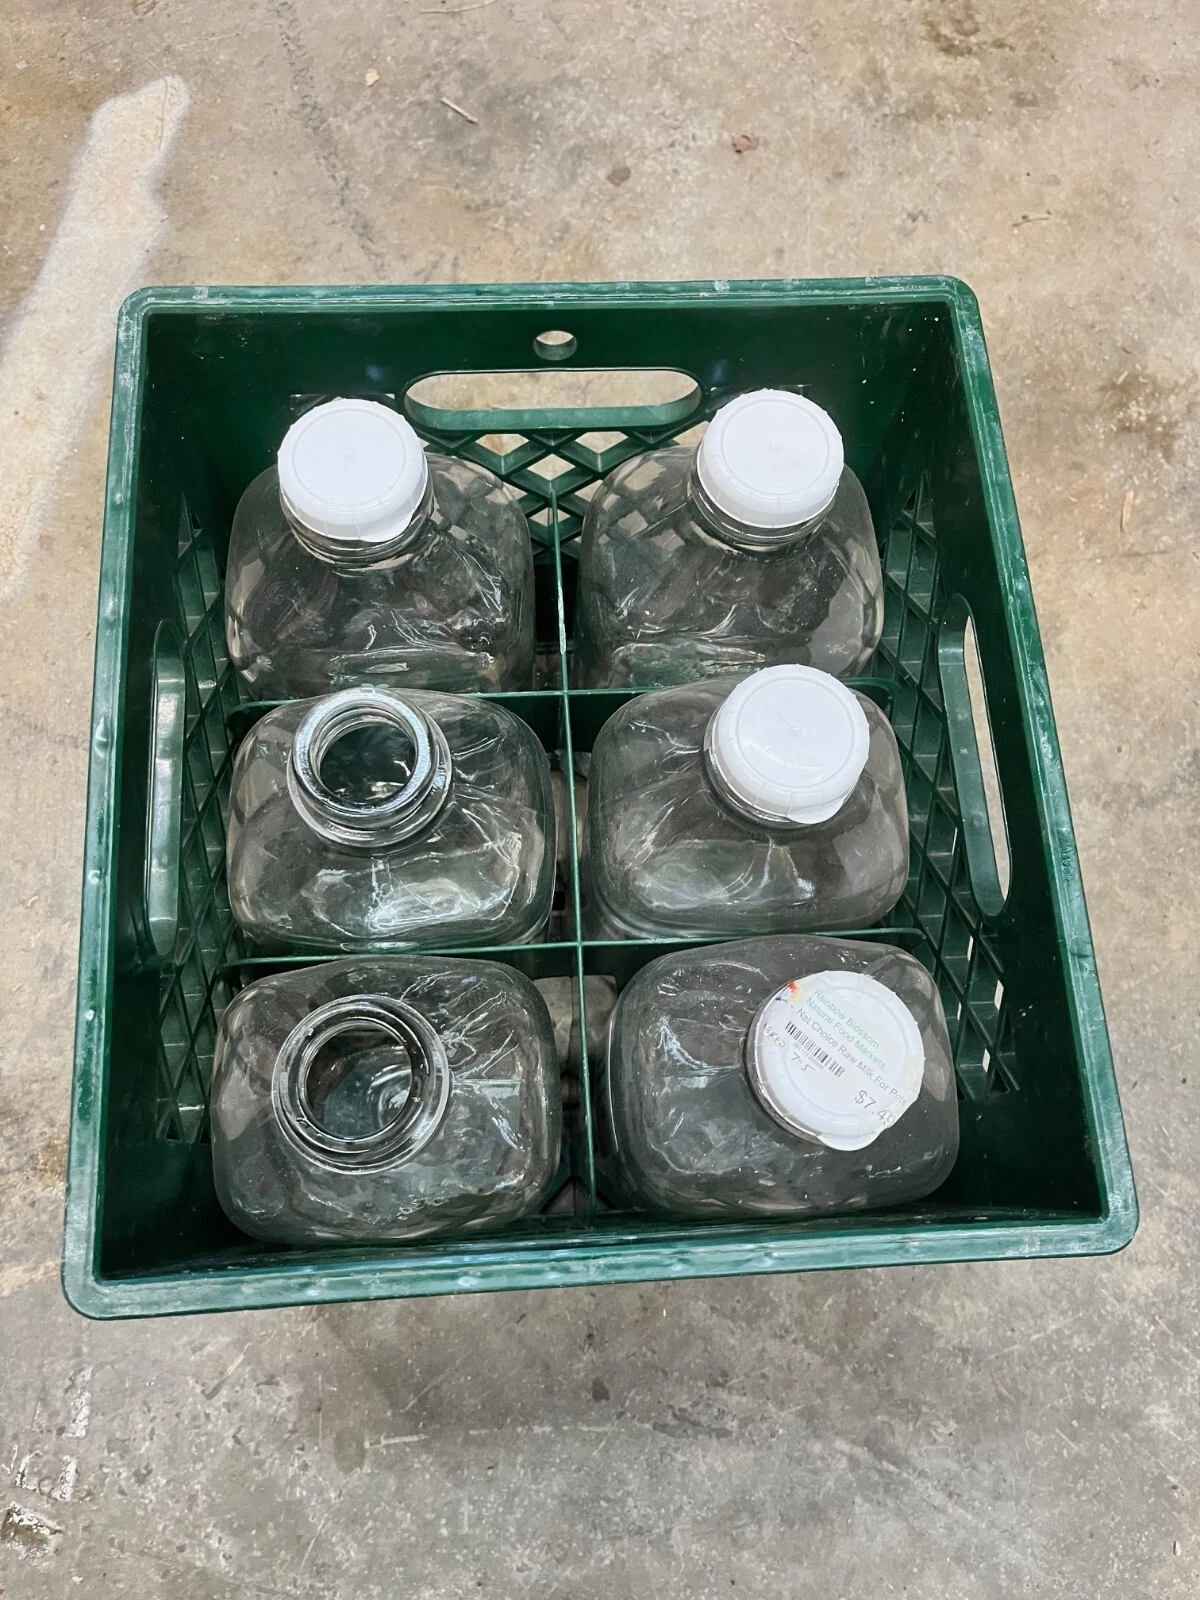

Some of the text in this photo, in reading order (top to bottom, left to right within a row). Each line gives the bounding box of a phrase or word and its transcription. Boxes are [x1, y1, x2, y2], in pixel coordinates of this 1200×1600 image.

[806, 998, 836, 1028] Natural
[834, 1021, 854, 1043] Food
[813, 989, 880, 1049] Rainbow Blossom
[797, 1008, 811, 1025] Nat
[811, 1021, 839, 1048] Choice
[838, 1045, 858, 1064] Raw
[857, 1060, 875, 1080] Milk
[874, 1075, 889, 1091] For
